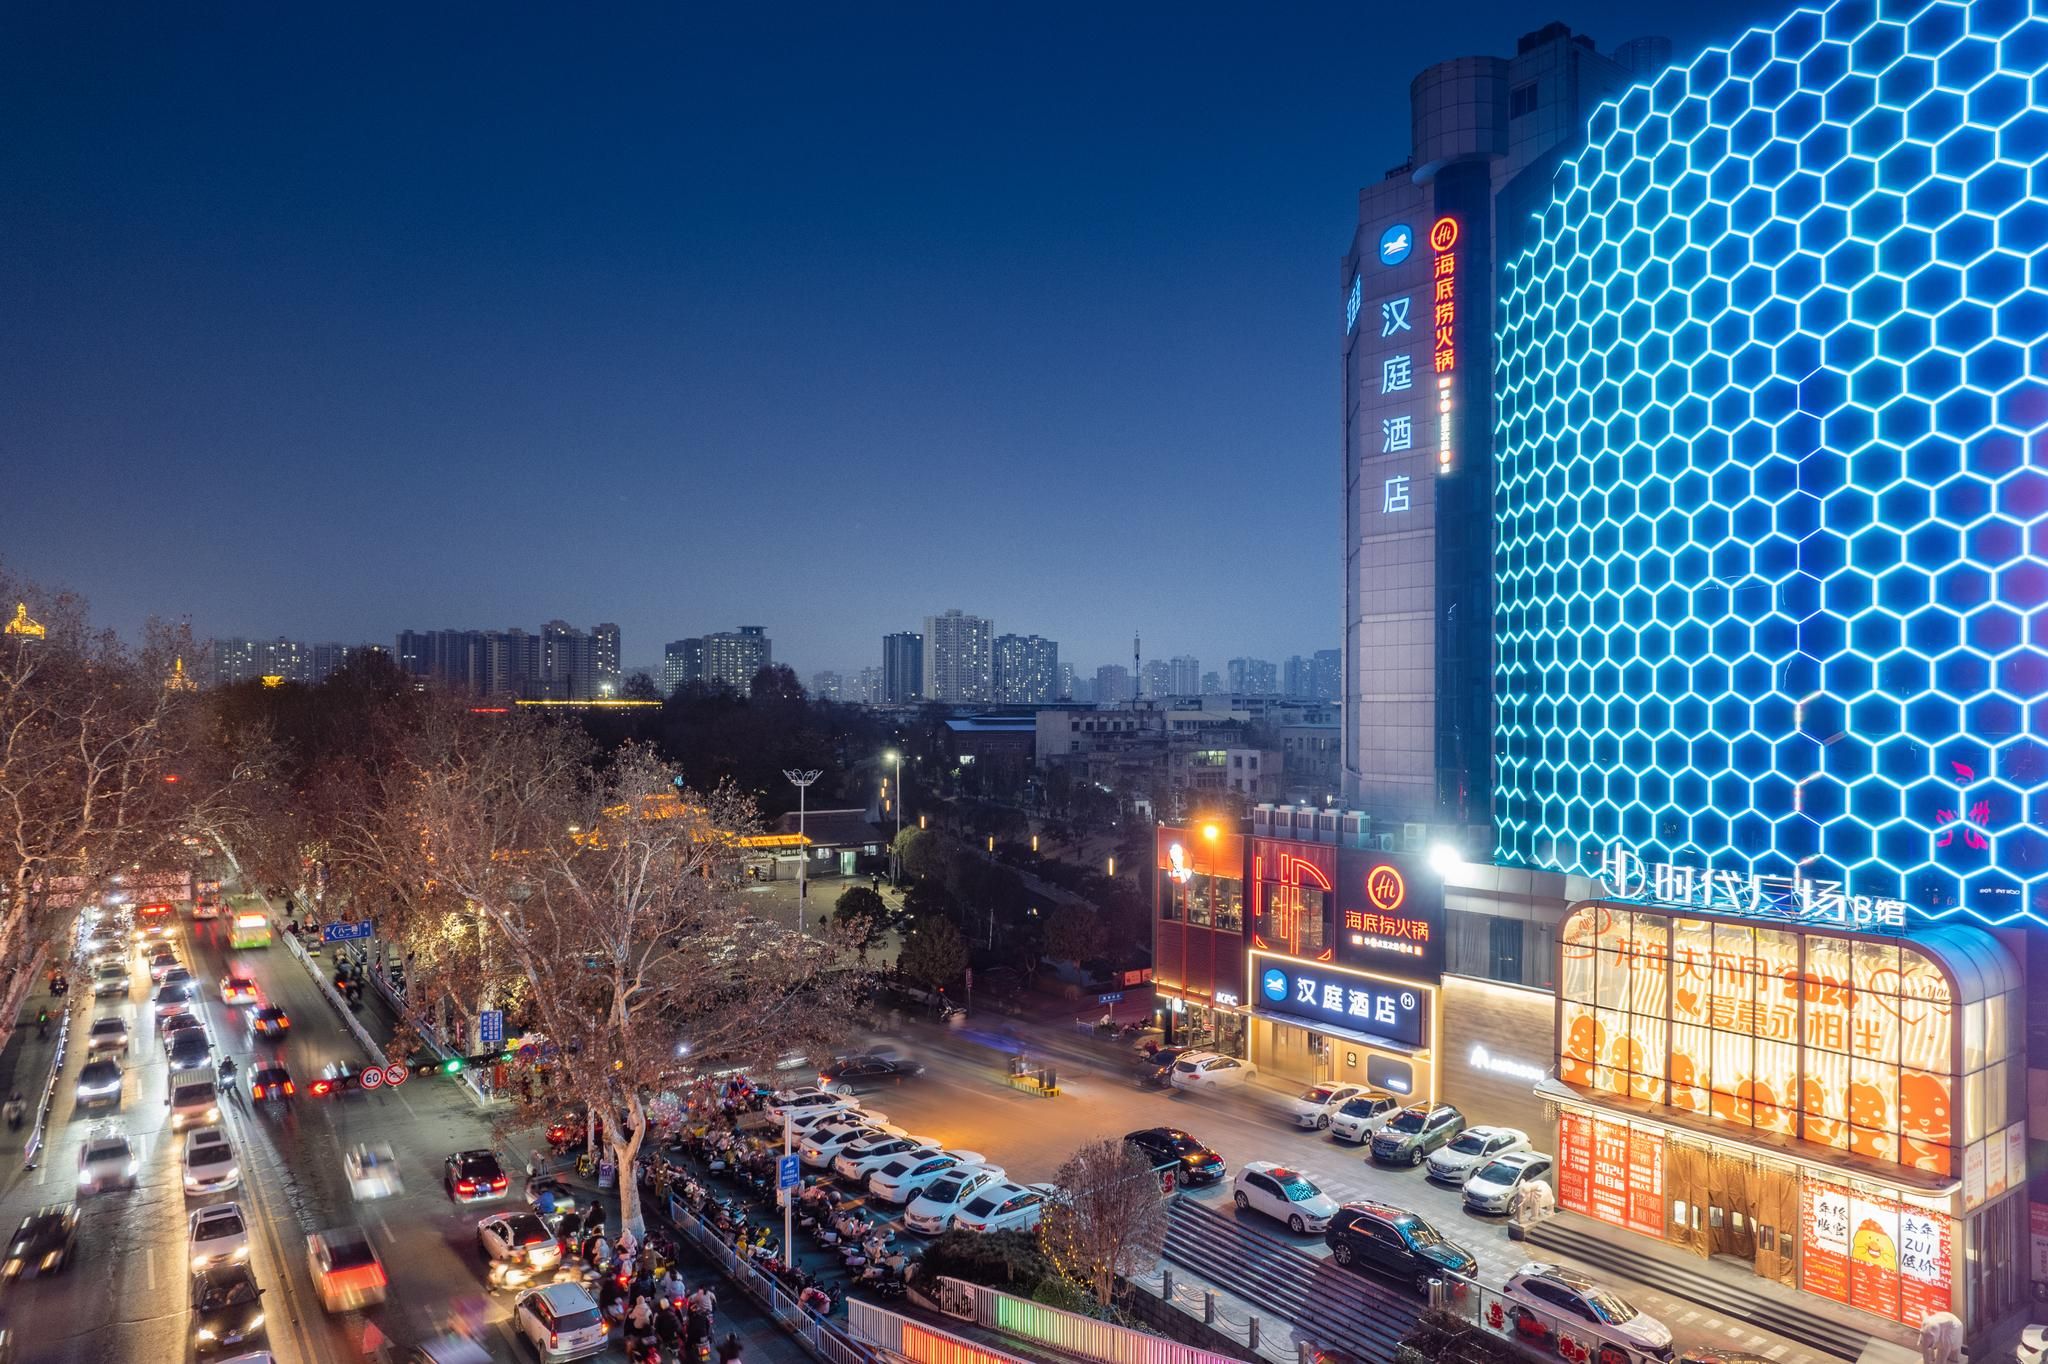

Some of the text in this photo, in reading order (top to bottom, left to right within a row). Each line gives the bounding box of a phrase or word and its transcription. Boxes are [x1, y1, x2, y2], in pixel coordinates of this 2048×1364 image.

[1434, 252, 1455, 373] 海底捞火锅
[1381, 297, 1413, 514] 汉庭酒店
[1344, 910, 1430, 942] 海底捞火锅
[1615, 937, 1769, 992] 龙年大不同
[1216, 991, 1239, 1006] KFC
[1296, 976, 1396, 1025] 汉庭酒店
[365, 1072, 380, 1083] 60
[1595, 1161, 1625, 1178] 2024
[1904, 1237, 1931, 1255] ZUI
